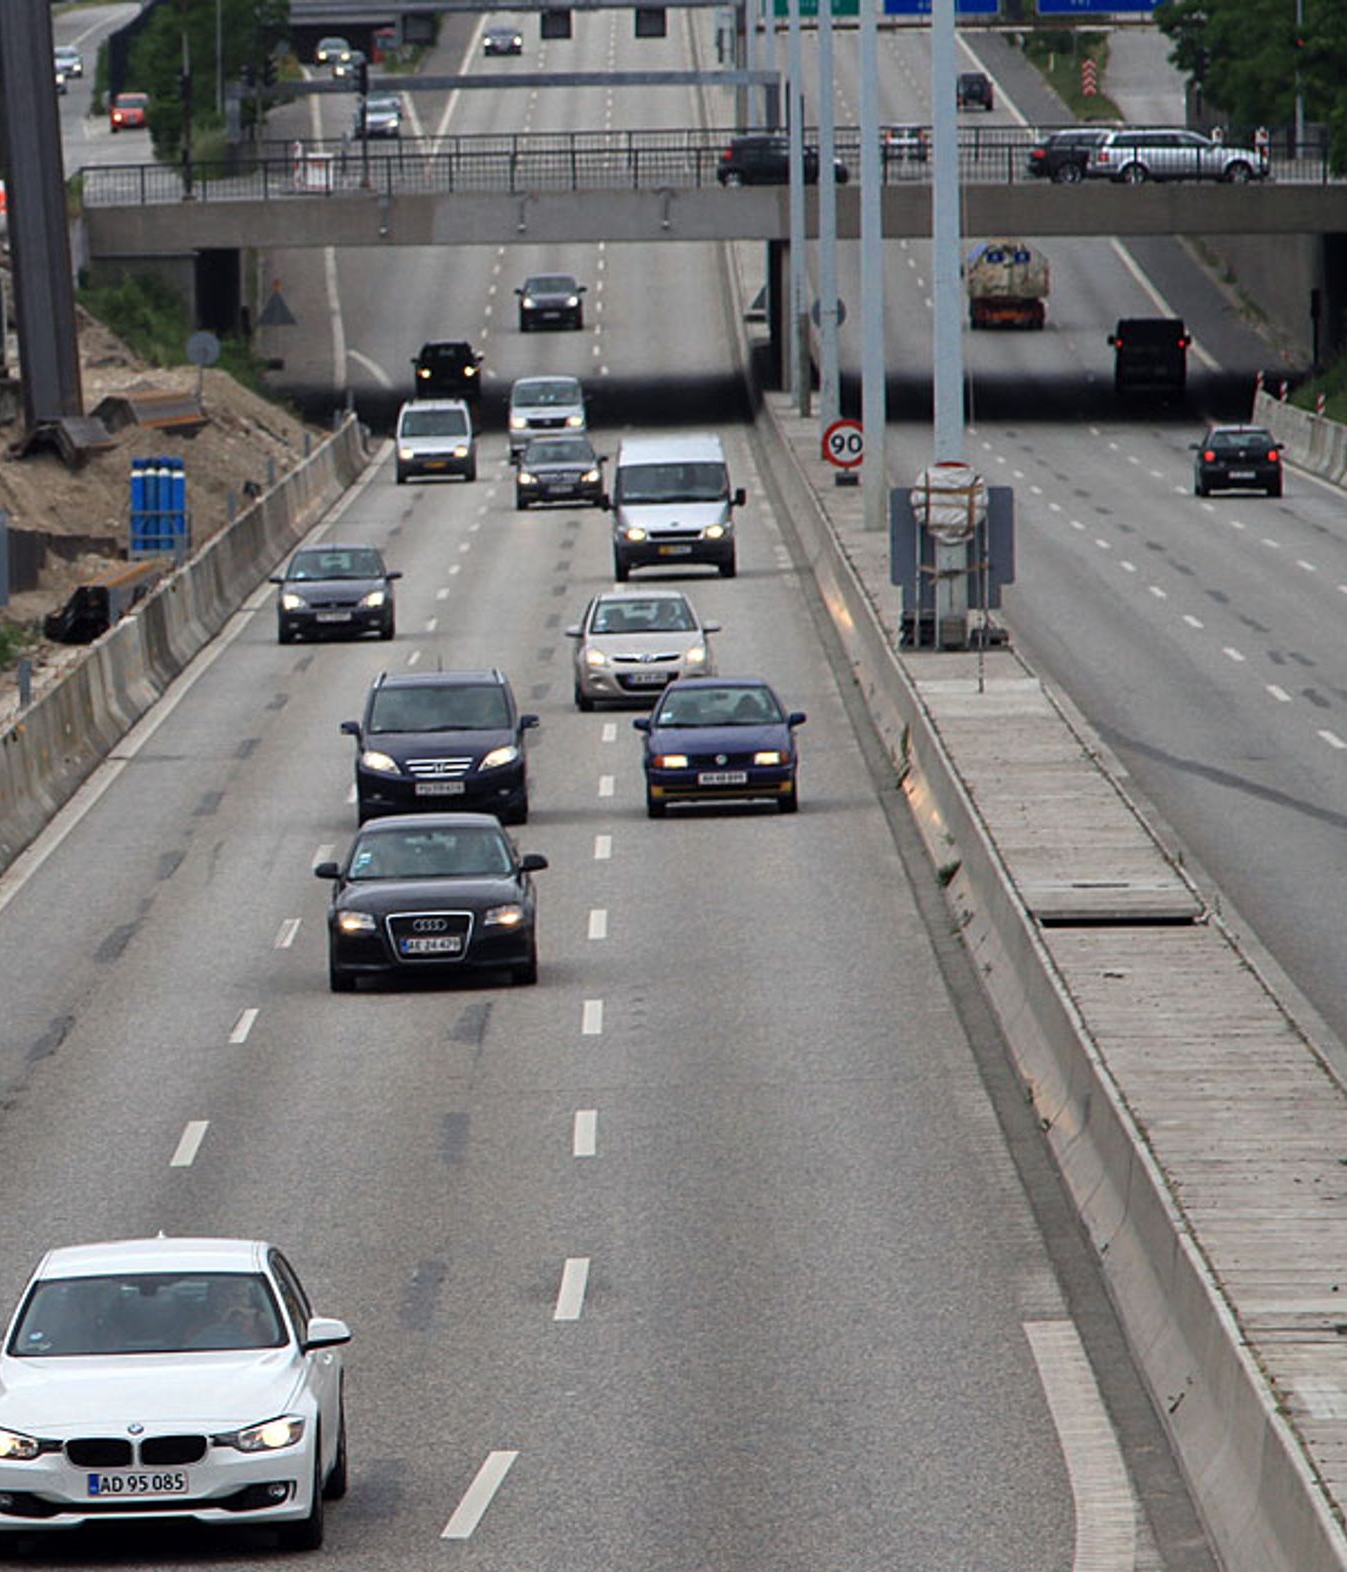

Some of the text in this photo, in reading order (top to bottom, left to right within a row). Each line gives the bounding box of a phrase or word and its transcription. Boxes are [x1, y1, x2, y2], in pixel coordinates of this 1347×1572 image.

[831, 434, 863, 454] 90
[100, 1473, 184, 1492] AD 95 085
